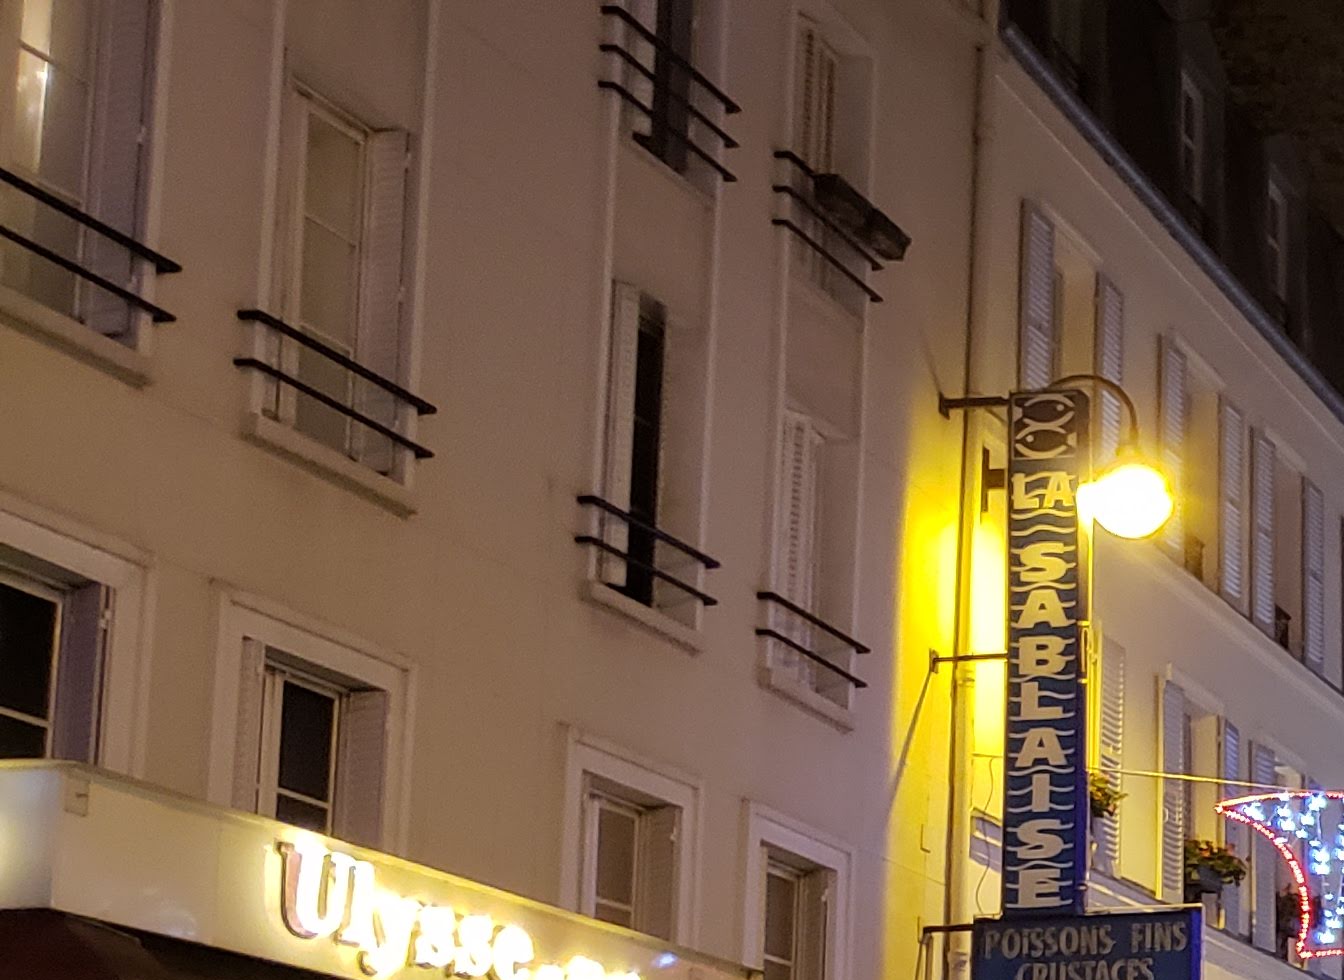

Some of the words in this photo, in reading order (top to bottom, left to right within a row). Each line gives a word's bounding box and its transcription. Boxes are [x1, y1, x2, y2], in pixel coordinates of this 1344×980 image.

[1012, 470, 1074, 510] LA
[1013, 542, 1070, 908] SABLAISE
[984, 923, 1117, 960] POISSONS
[1131, 920, 1188, 953] FINS
